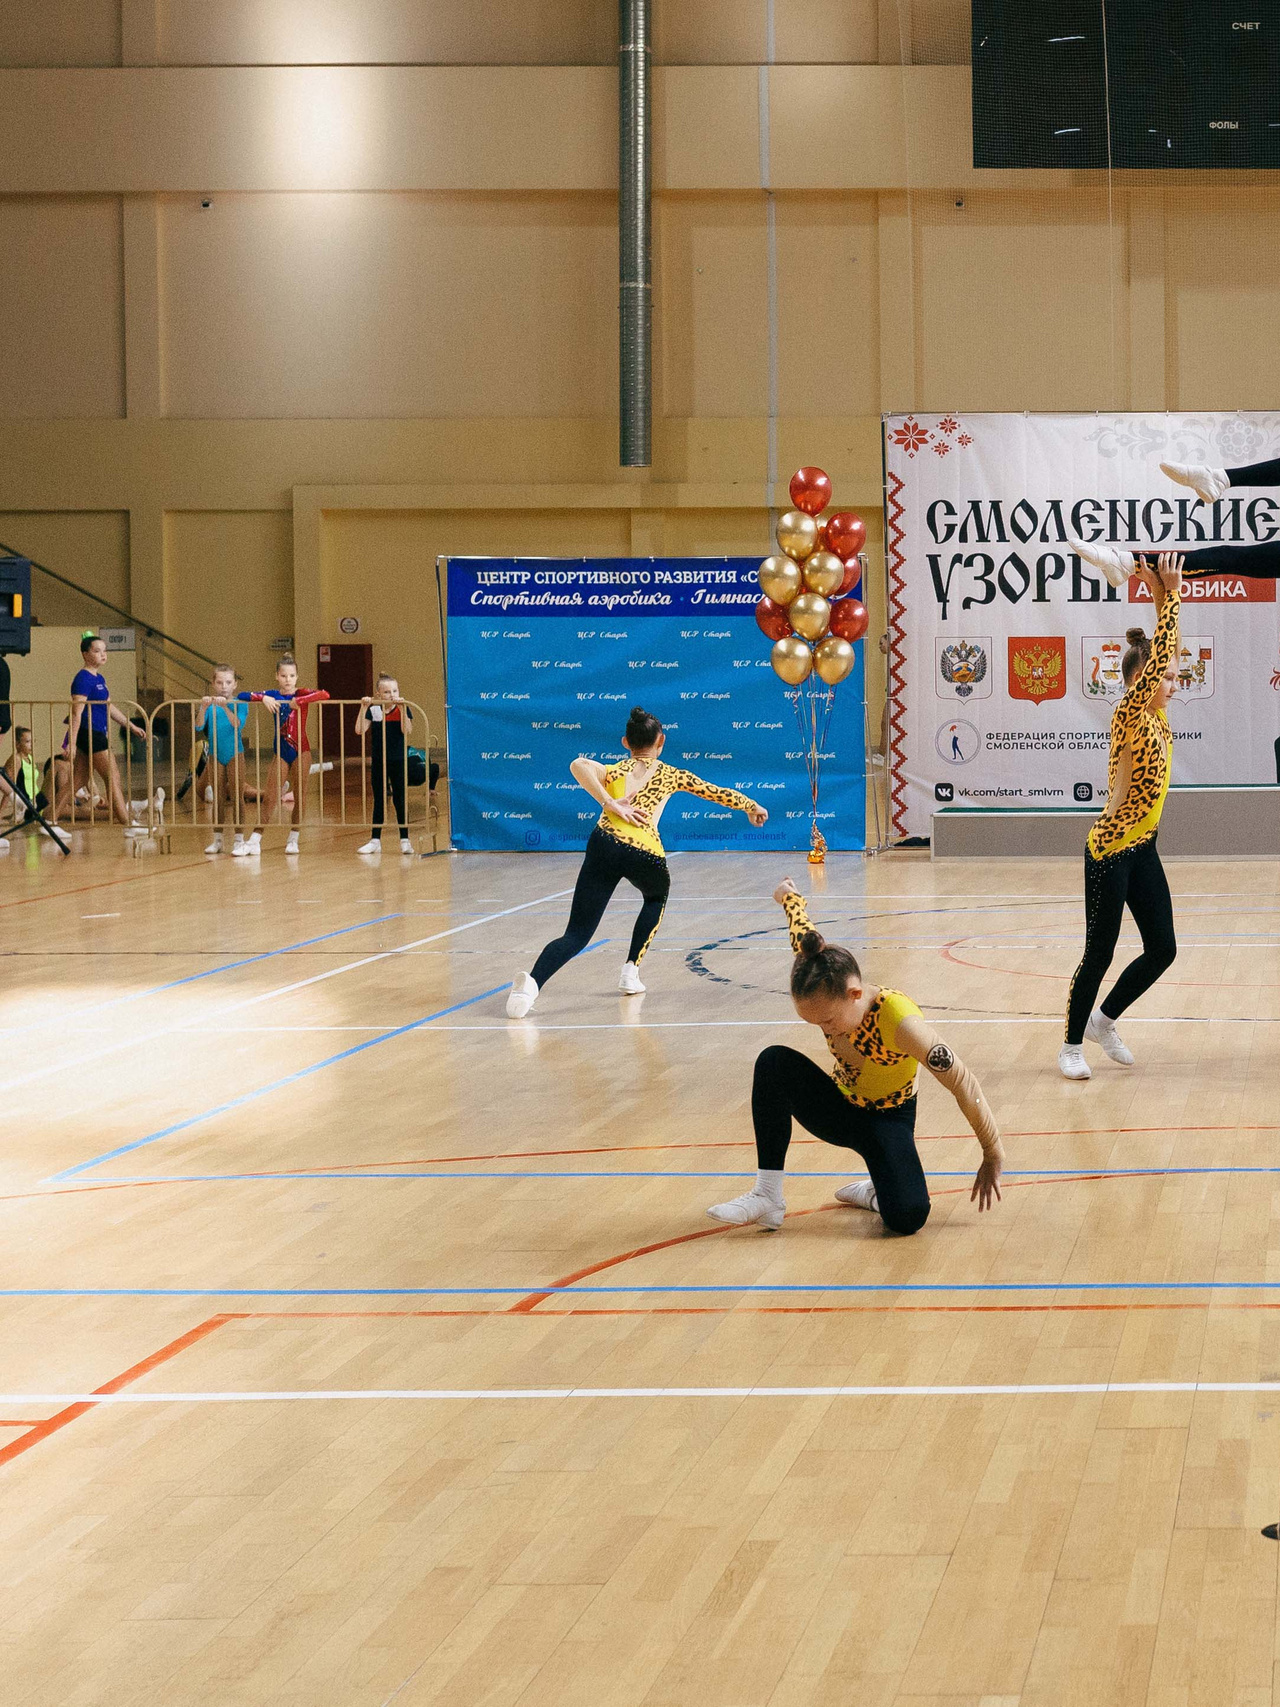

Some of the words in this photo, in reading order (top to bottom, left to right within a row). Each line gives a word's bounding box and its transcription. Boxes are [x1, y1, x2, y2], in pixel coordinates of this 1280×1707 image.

[1232, 22, 1261, 30] СЧЕТ
[1209, 121, 1239, 130] ФОЛЫ
[926, 497, 1280, 544] СМОЛЕНСКИЕ
[477, 571, 531, 586] ЦЕНТР
[534, 571, 651, 585] СПОРТИВНОГО
[654, 570, 737, 584] РАЗВИТИЯ
[926, 551, 1121, 620] УЗОРЫ
[1135, 580, 1248, 598] АОБИКА
[470, 590, 585, 611] Спортивная
[588, 589, 673, 611] аэробика
[691, 589, 765, 605] Гимнас
[755, 659, 771, 669] Ста
[985, 732, 1056, 742] ФЕДЕРАЦИЯ
[985, 741, 1064, 750] СМОЛЕНСКОЙ
